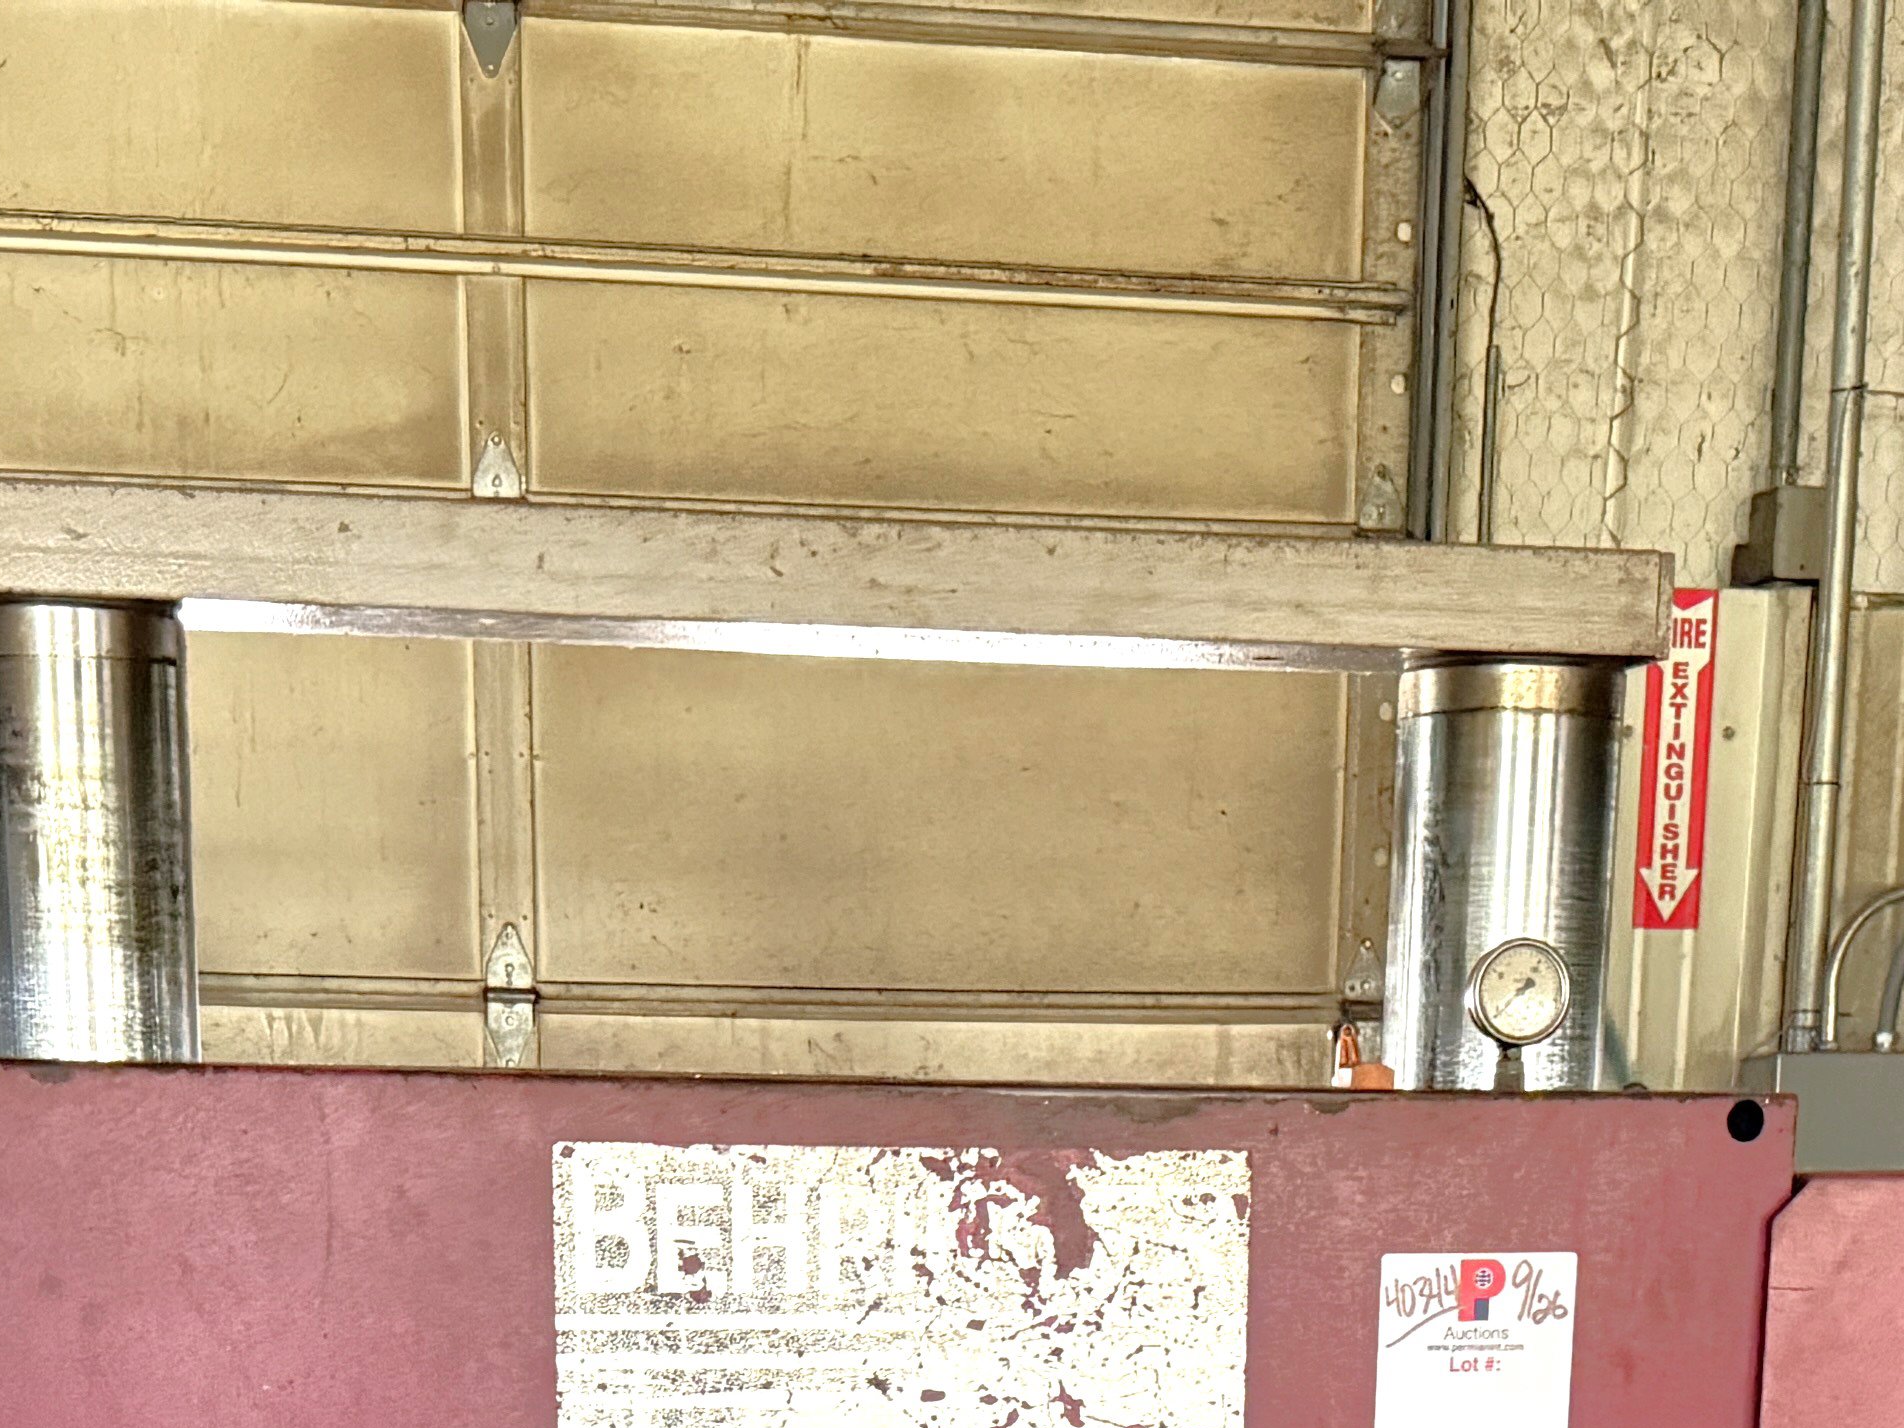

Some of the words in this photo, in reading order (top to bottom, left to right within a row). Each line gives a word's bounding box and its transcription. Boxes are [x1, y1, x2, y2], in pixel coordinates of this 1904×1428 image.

[1671, 617, 1707, 649] IRE
[1658, 661, 1690, 901] EXTINGUISHER
[1443, 1327, 1510, 1340] Auctions
[1449, 1356, 1479, 1373] Lot
